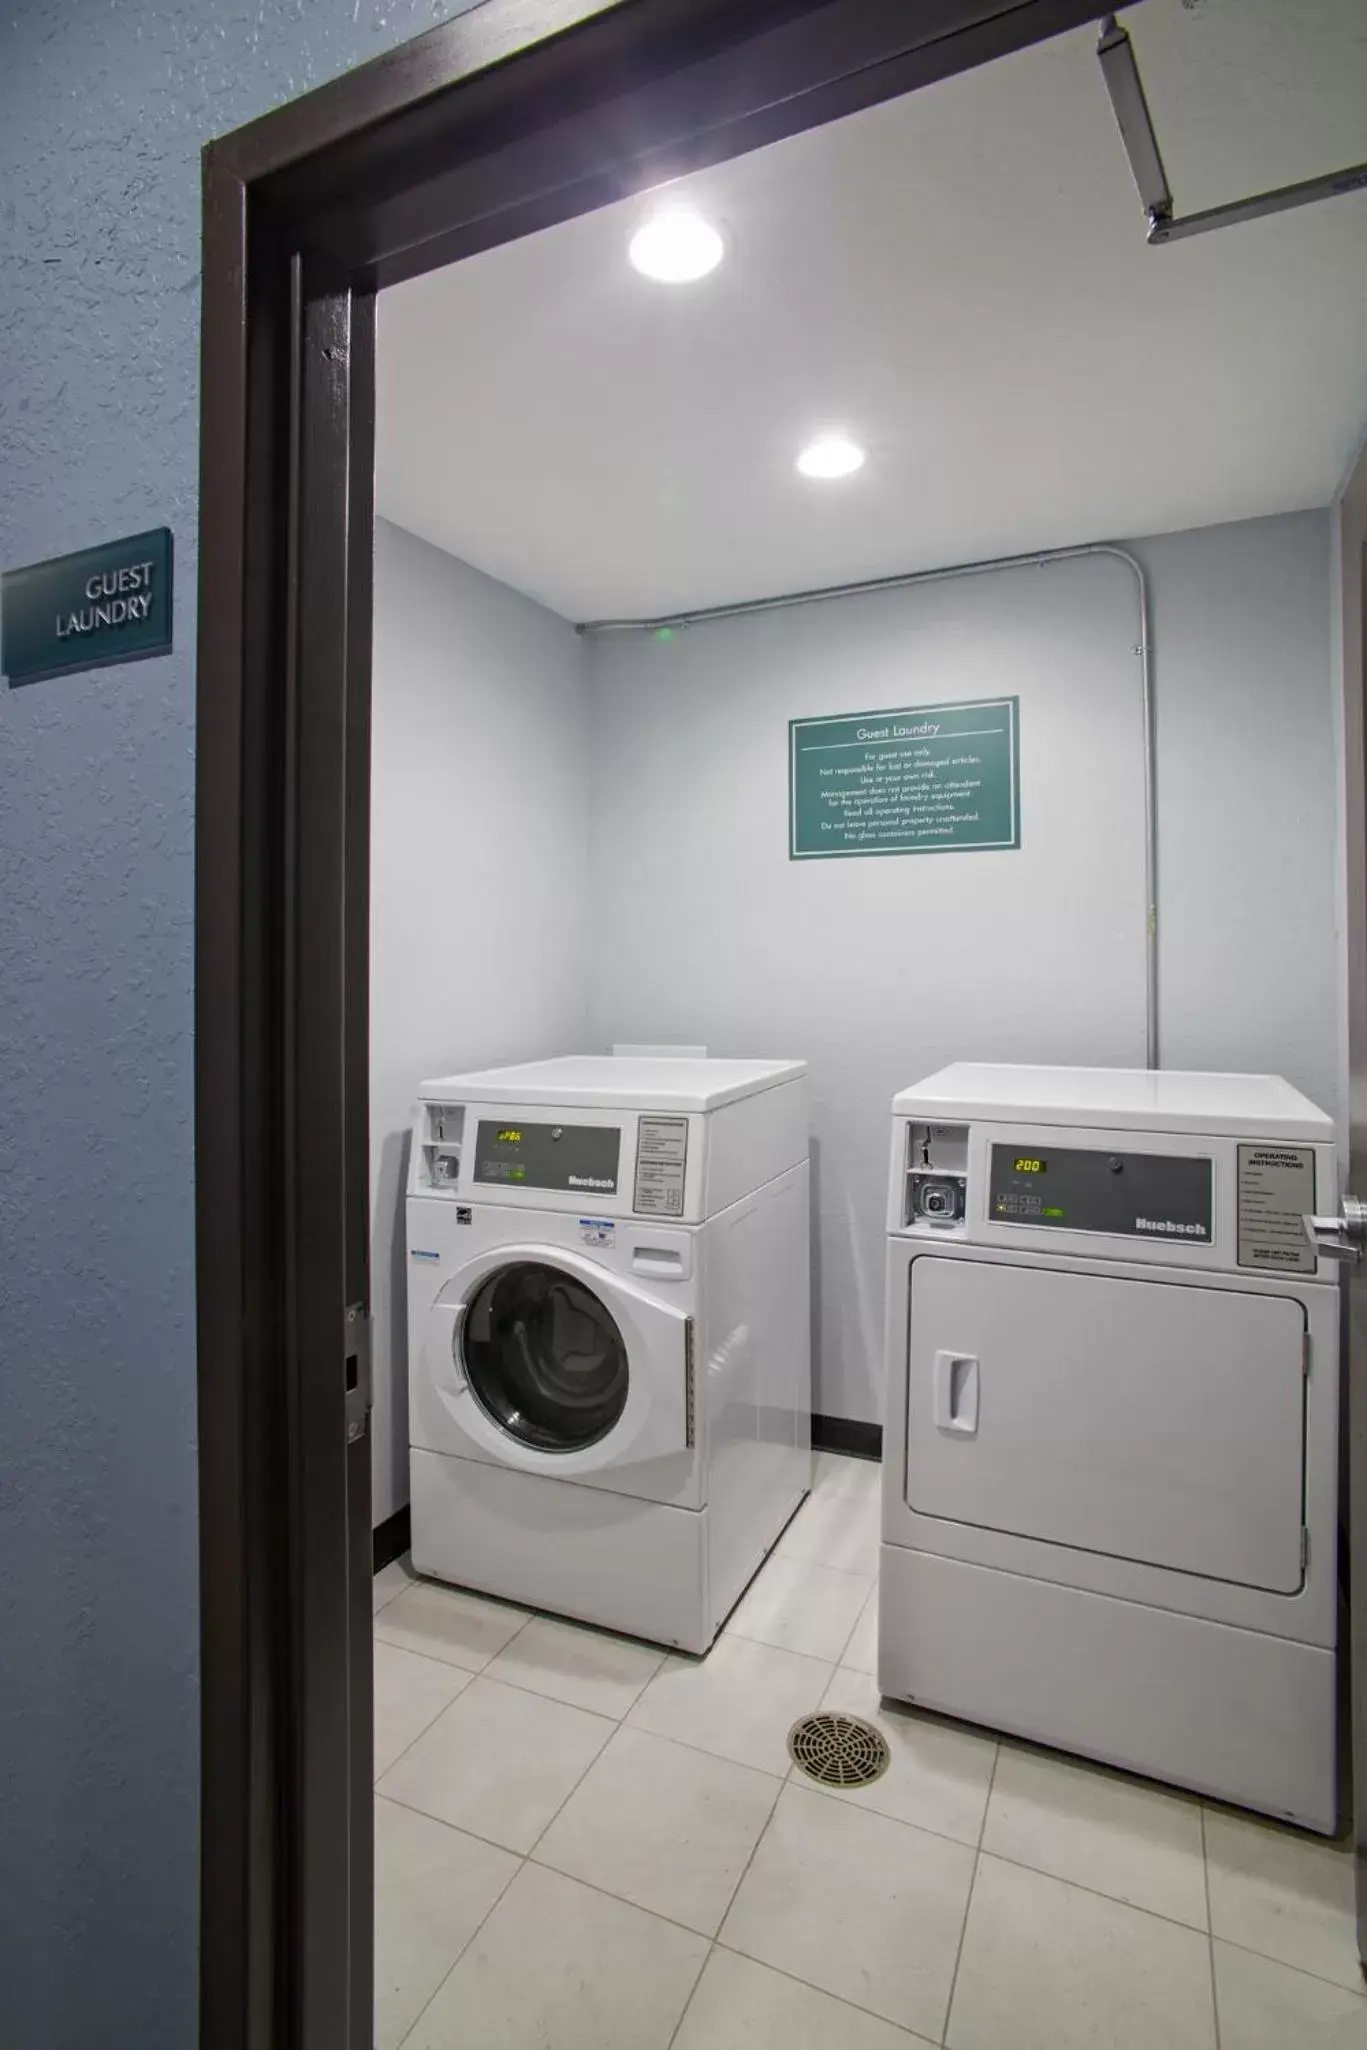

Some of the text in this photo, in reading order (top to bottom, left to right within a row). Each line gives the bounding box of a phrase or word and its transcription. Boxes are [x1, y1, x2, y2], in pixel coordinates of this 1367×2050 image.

[85, 561, 153, 599] GUEST
[56, 592, 153, 637] LAUNDRY
[857, 721, 941, 740] Guest Laundry
[865, 752, 875, 761] For
[879, 751, 897, 761] guest
[820, 768, 833, 776] Not
[835, 764, 873, 776] responsible
[876, 763, 886, 771] for
[889, 761, 901, 770] lost
[914, 757, 949, 769] damaged
[860, 776, 872, 784] Use
[885, 774, 901, 784] your
[821, 788, 867, 799] Management
[869, 786, 885, 795] does
[888, 786, 900, 794] not
[902, 783, 929, 793] provide
[875, 806, 910, 816] operating
[821, 821, 831, 830] Do
[847, 819, 866, 828] leave
[868, 817, 899, 828] personal
[902, 816, 933, 827] property
[1254, 1152, 1297, 1161] OPERATING
[1015, 1159, 1040, 1172] 200
[1248, 1159, 1304, 1169] INSTRUCTIONS
[1135, 1216, 1207, 1235] Huebsch
